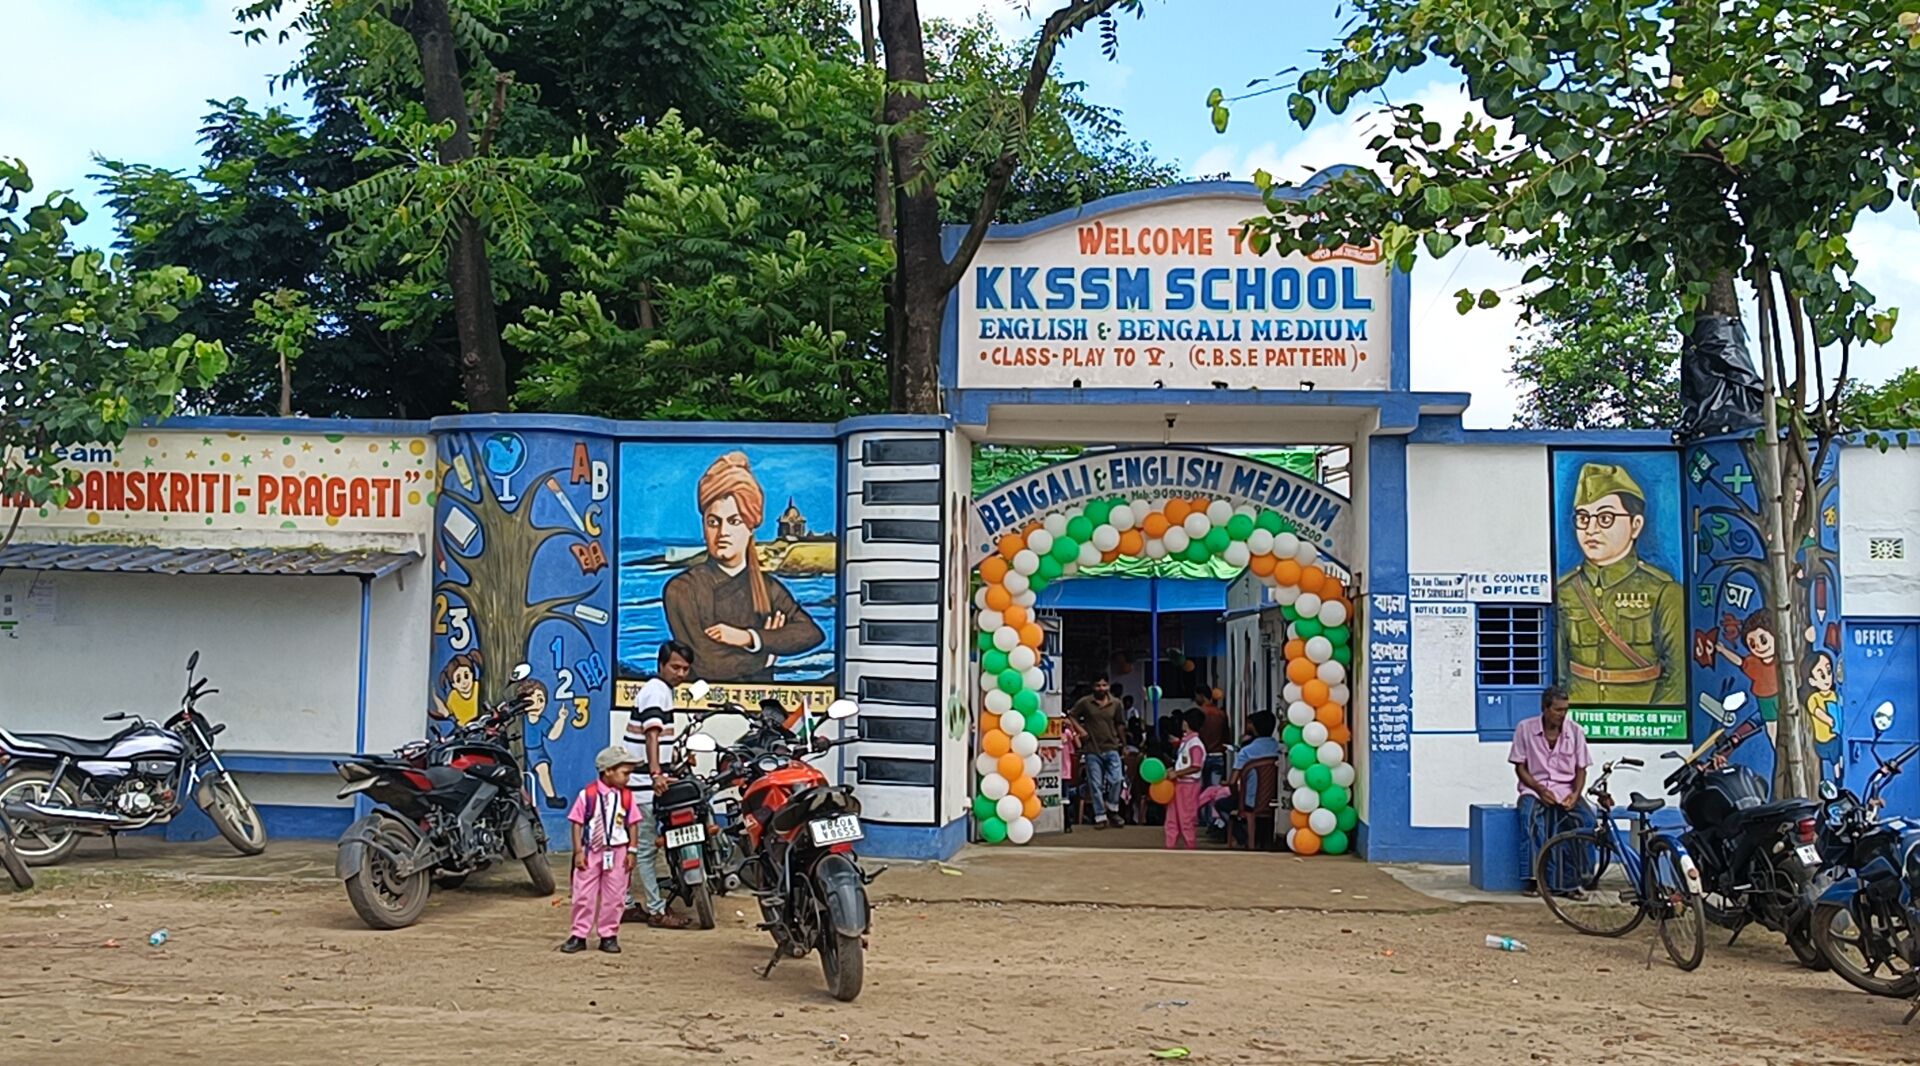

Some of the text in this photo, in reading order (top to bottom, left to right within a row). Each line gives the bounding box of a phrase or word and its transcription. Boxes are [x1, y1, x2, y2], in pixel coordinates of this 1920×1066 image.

[1078, 221, 1212, 256] WELCOME
[976, 266, 1373, 310] KKSSM SCHOOL
[979, 318, 1089, 340] ENGLISH
[1118, 319, 1242, 341] BENGALI
[1251, 319, 1368, 341] MEDIUM
[1114, 348, 1136, 366] TO
[592, 460, 609, 501] B
[978, 464, 1092, 536] BENGALI
[1109, 456, 1223, 491] ENGLISH
[1229, 465, 1341, 532] MEDIUM
[585, 503, 602, 537] C
[1468, 574, 1487, 583] FEE
[1493, 574, 1549, 583] COUNTER
[1482, 585, 1540, 595] OFFICE
[1414, 606, 1468, 614] NOTICE BOARD
[449, 607, 471, 650] 3
[1855, 629, 1893, 645] OFFICE
[555, 669, 575, 700] 2
[571, 697, 590, 729] 3
